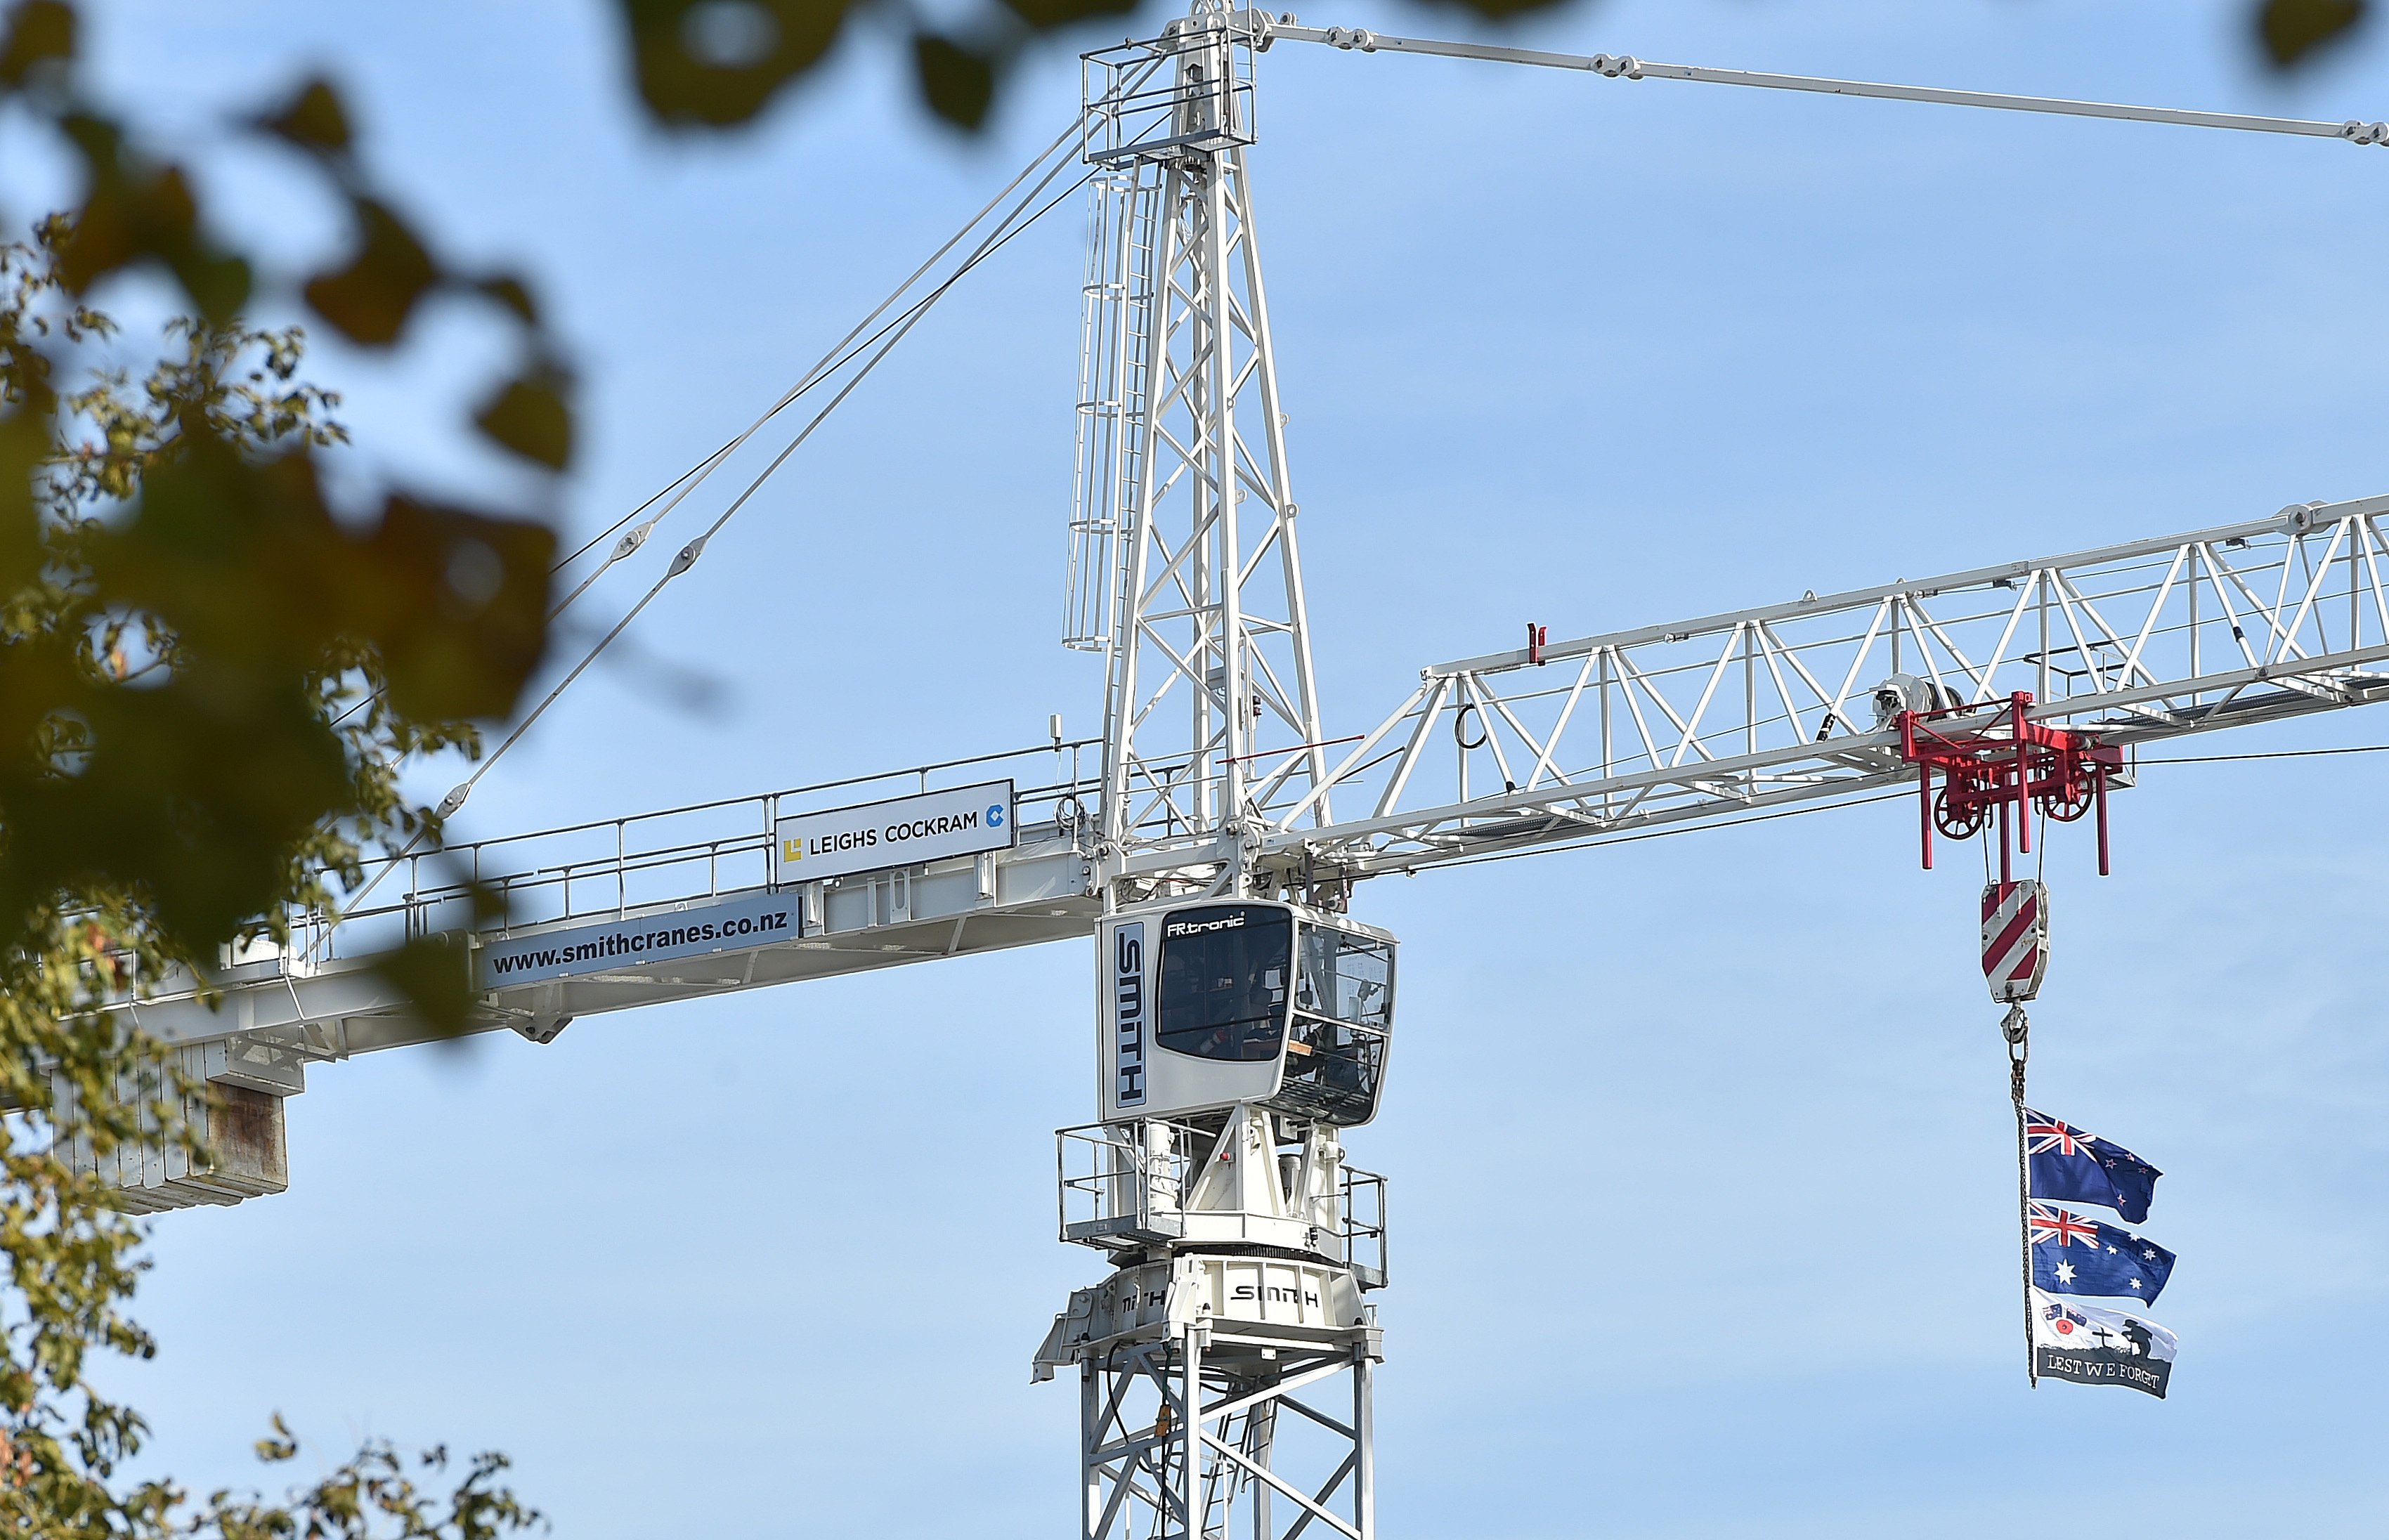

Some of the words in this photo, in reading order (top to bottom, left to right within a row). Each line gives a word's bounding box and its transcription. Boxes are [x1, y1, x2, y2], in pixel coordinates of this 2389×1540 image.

[809, 828, 878, 856] LEIGHS
[885, 811, 977, 843] COCKRAM
[493, 911, 788, 974] www.smithcranes.co.nz
[1119, 932, 1142, 1101] SMITH
[2047, 1355, 2082, 1375] LEST
[2084, 1361, 2116, 1378] WE
[2118, 1363, 2160, 1389] FORGET
